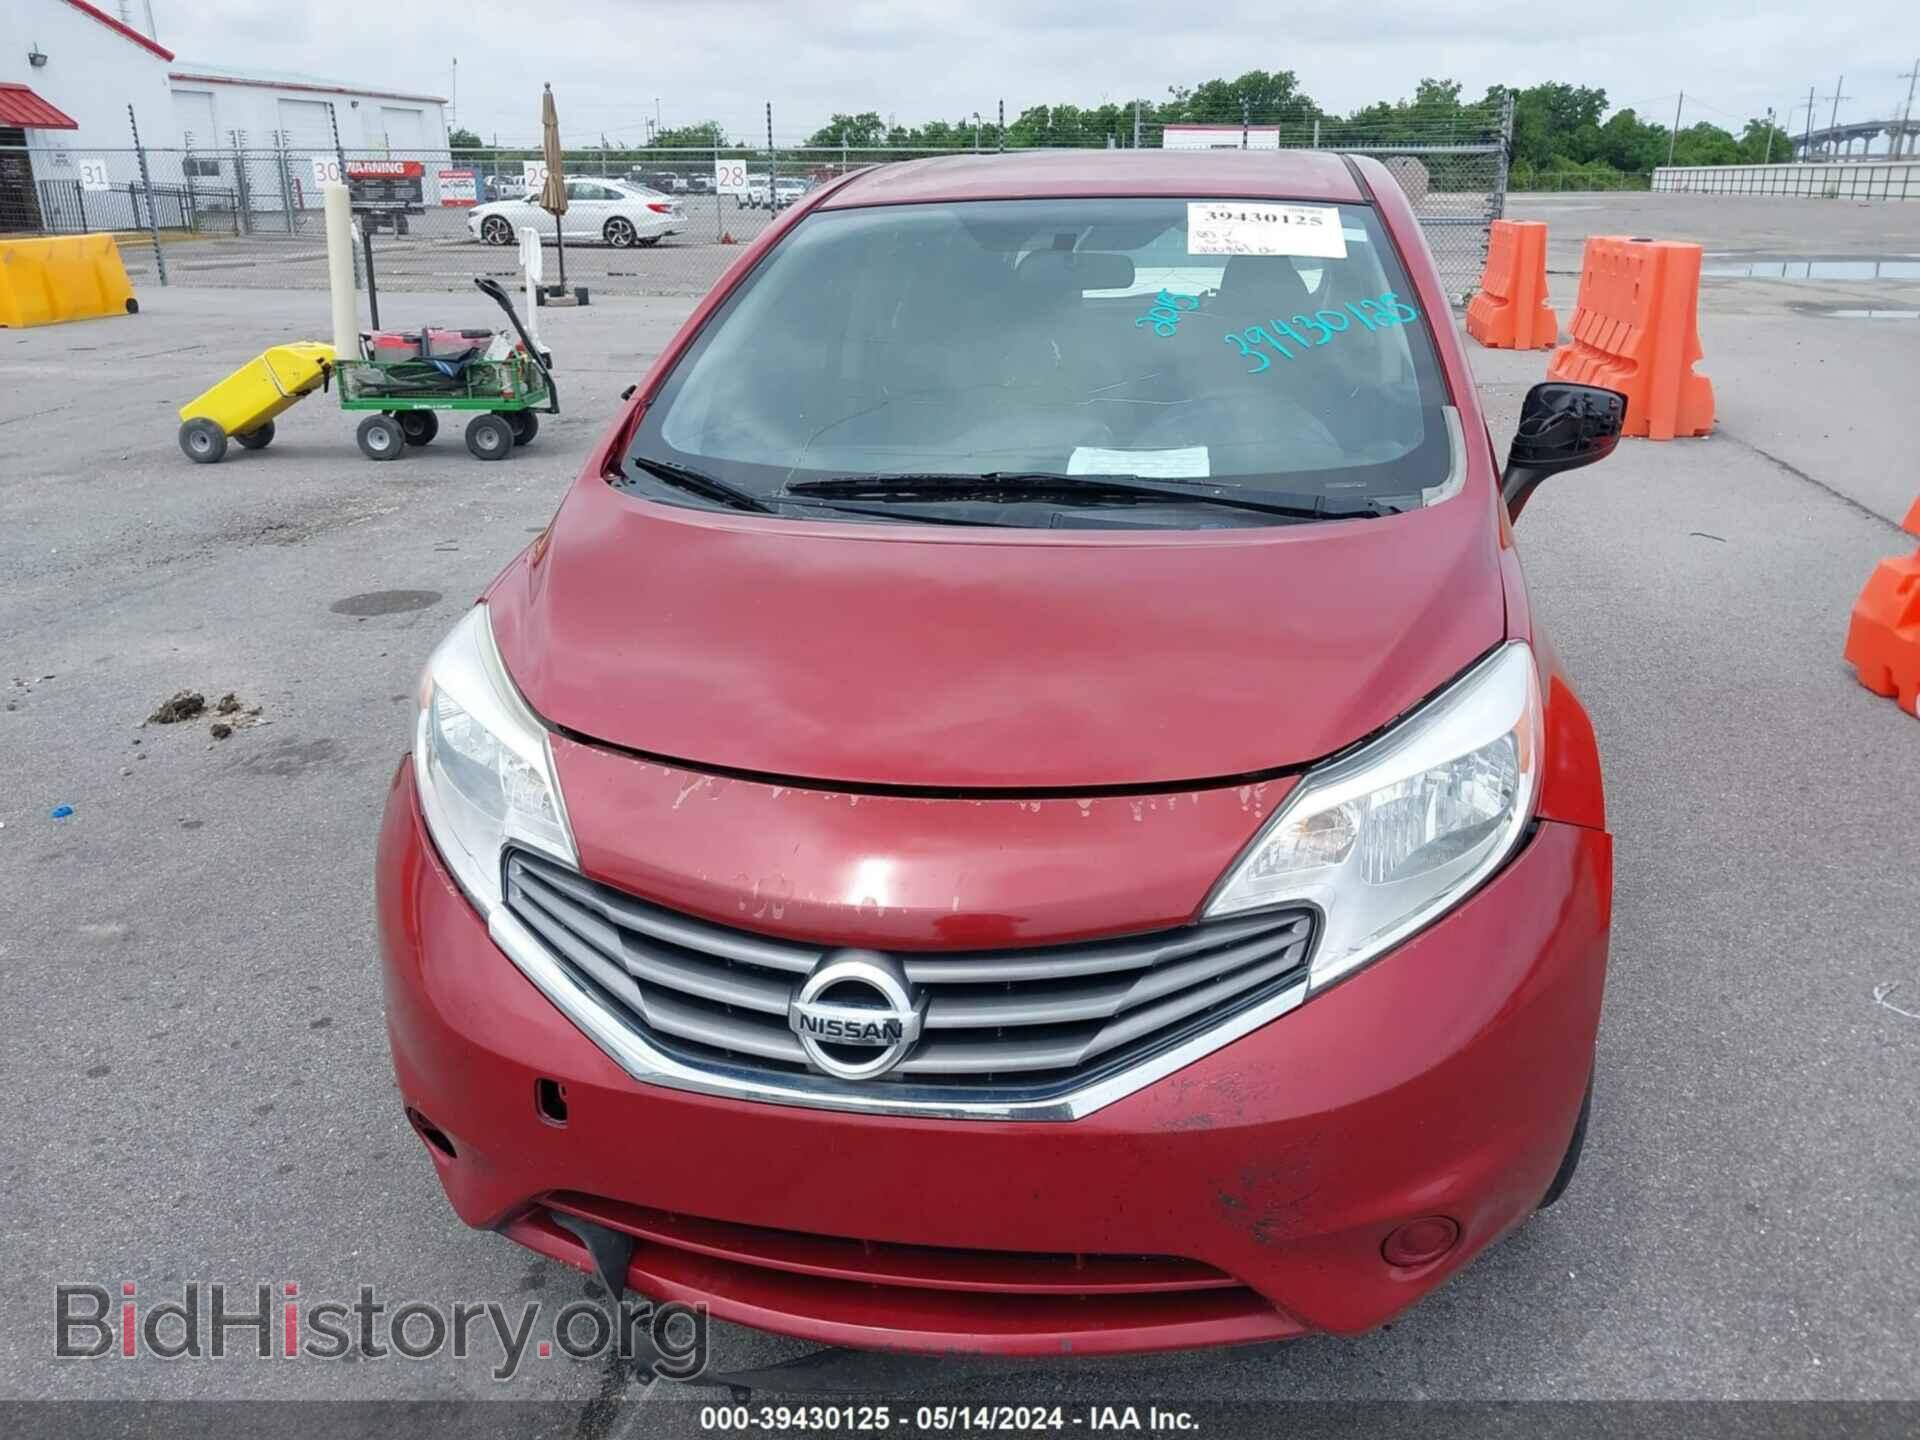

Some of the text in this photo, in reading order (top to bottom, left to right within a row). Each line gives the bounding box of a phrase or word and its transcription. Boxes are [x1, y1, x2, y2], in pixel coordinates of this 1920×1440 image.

[83, 165, 105, 184] 31
[315, 162, 339, 182] 30
[345, 162, 405, 174] WARNING
[719, 166, 744, 187] 28
[1204, 210, 1323, 226] 39430125
[1224, 291, 1420, 374] 39430125
[800, 1014, 903, 1039] NISSAN
